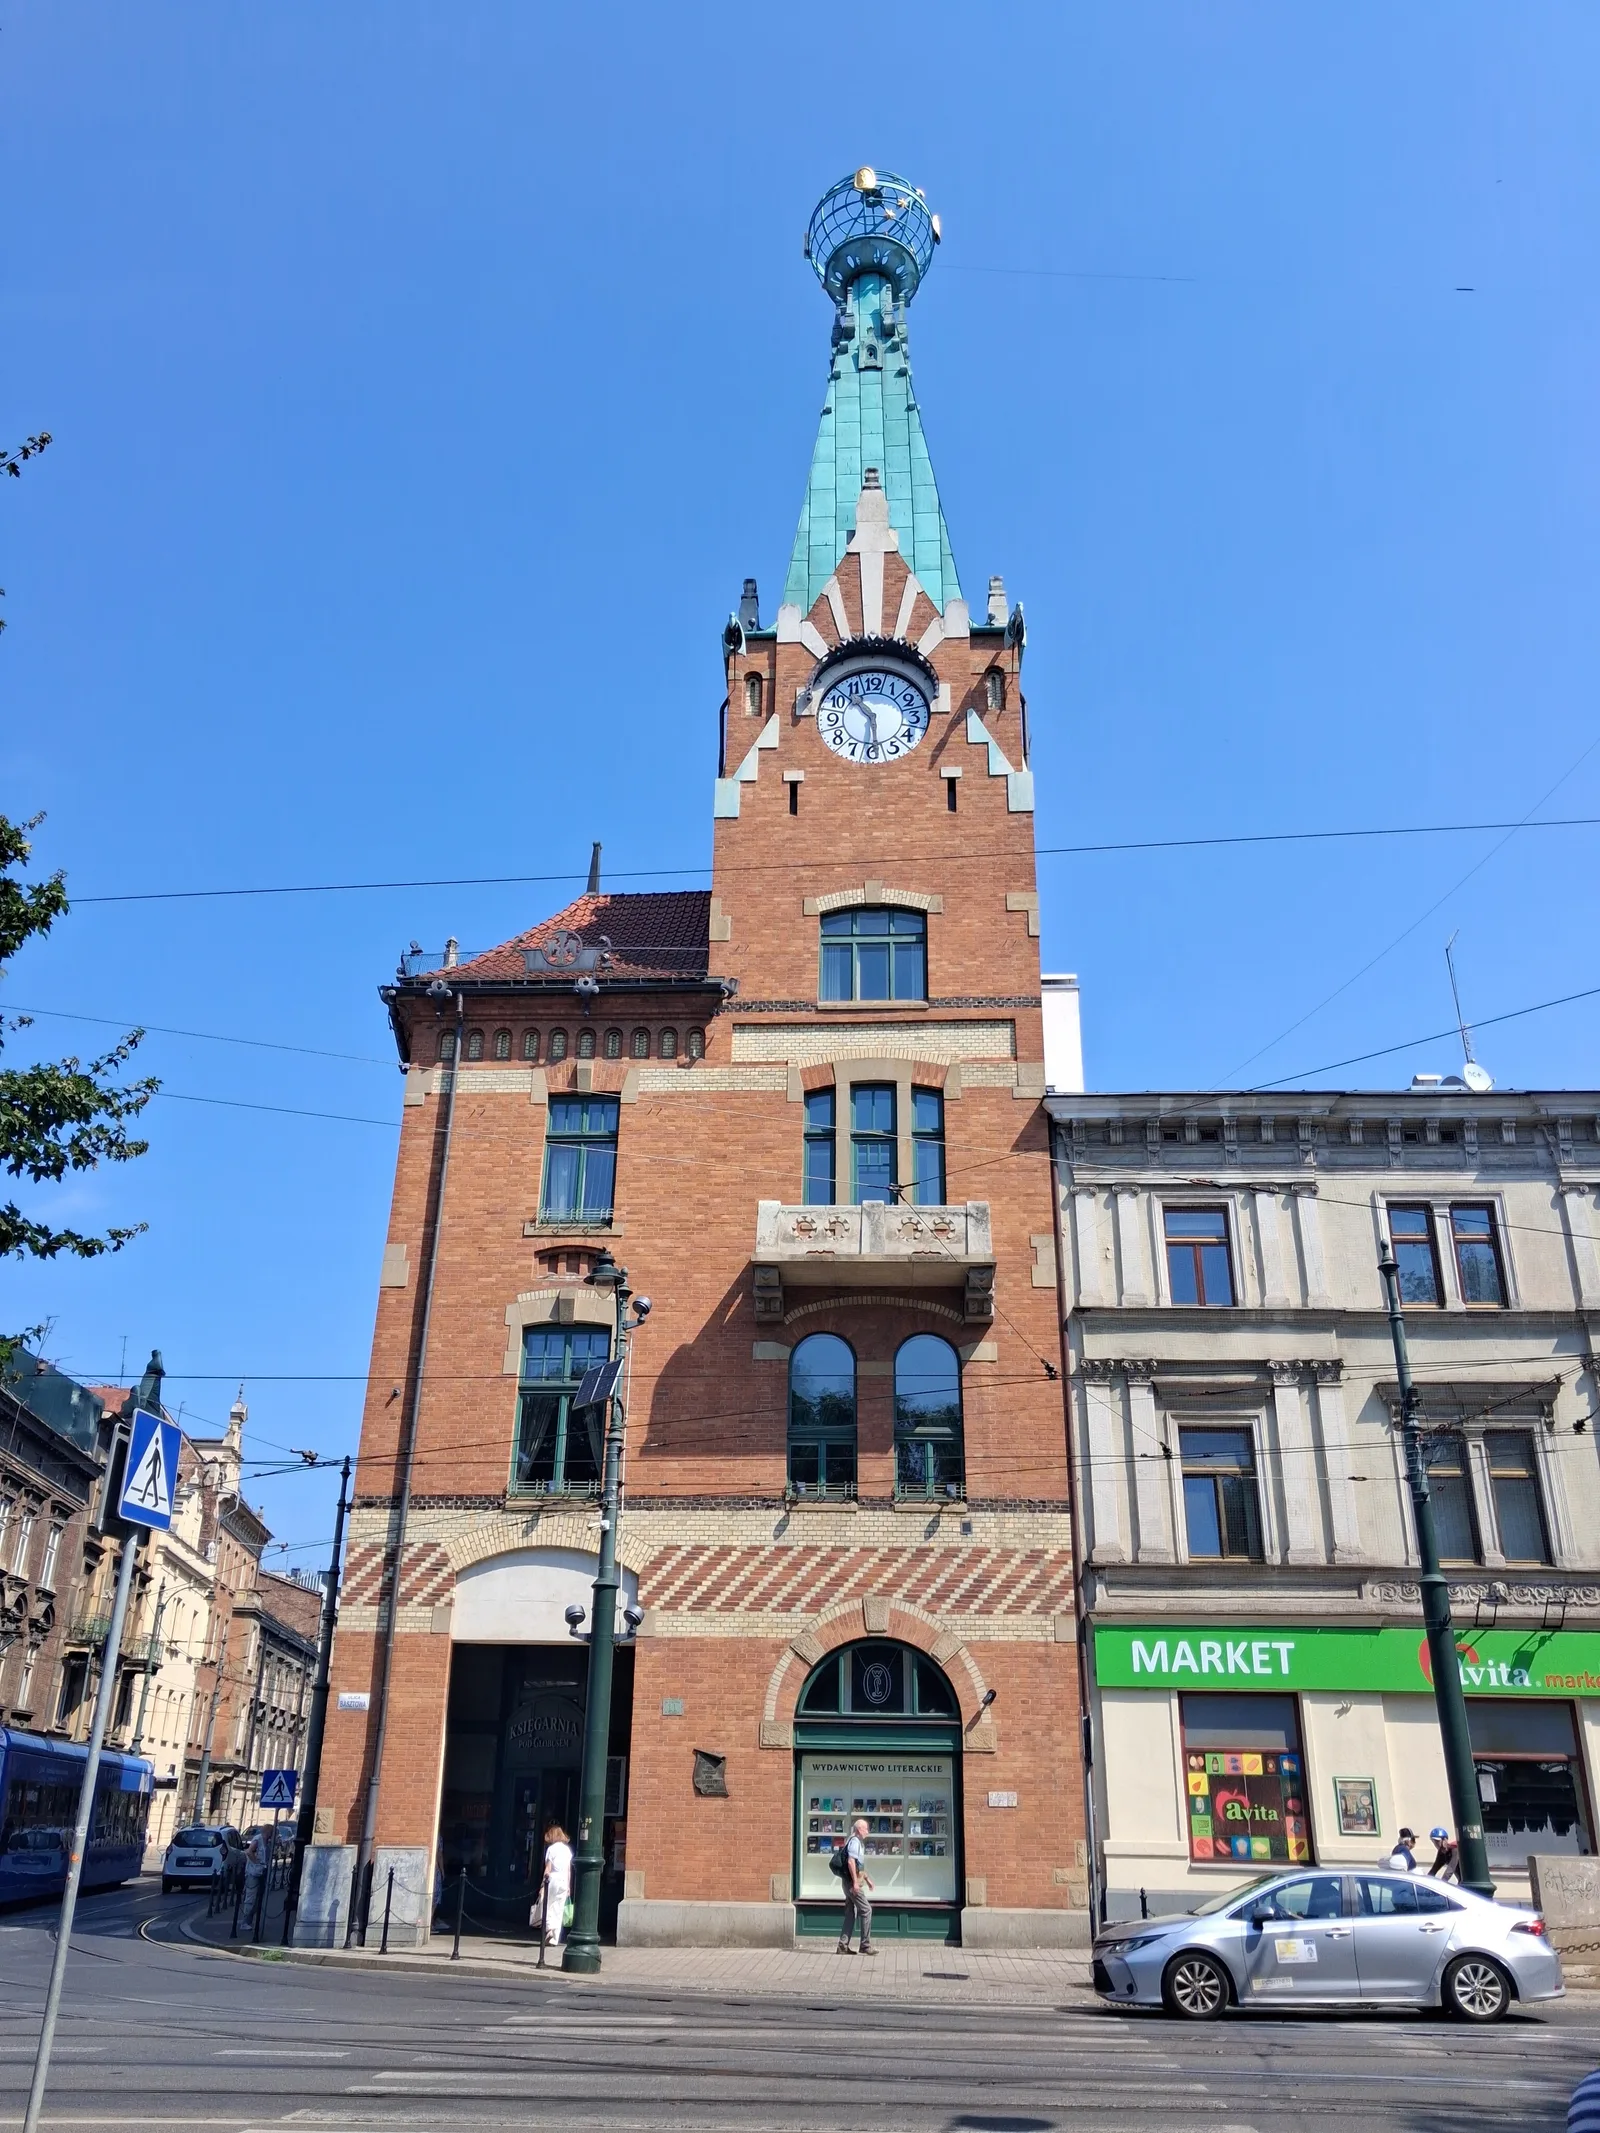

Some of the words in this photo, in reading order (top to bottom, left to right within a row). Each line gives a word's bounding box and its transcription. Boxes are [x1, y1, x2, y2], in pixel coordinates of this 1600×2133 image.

[848, 681, 860, 696] 11
[865, 677, 882, 692] 12
[889, 683, 895, 696] 1
[831, 695, 845, 709] 10
[903, 693, 915, 707] 2
[827, 713, 839, 726] 9
[908, 711, 920, 724] 3
[832, 729, 844, 745] 8
[901, 728, 913, 742] 4
[848, 743, 858, 756] 7
[867, 745, 879, 759] 6
[887, 741, 900, 754] 5
[1131, 1640, 1295, 1675] MARKET
[509, 1716, 578, 1740] KSIĘGARNIA
[518, 1739, 532, 1748] POD
[812, 1763, 885, 1772] WYDAWNICTWO
[888, 1765, 943, 1773] LITERACKIE
[1226, 1801, 1279, 1821] avita
